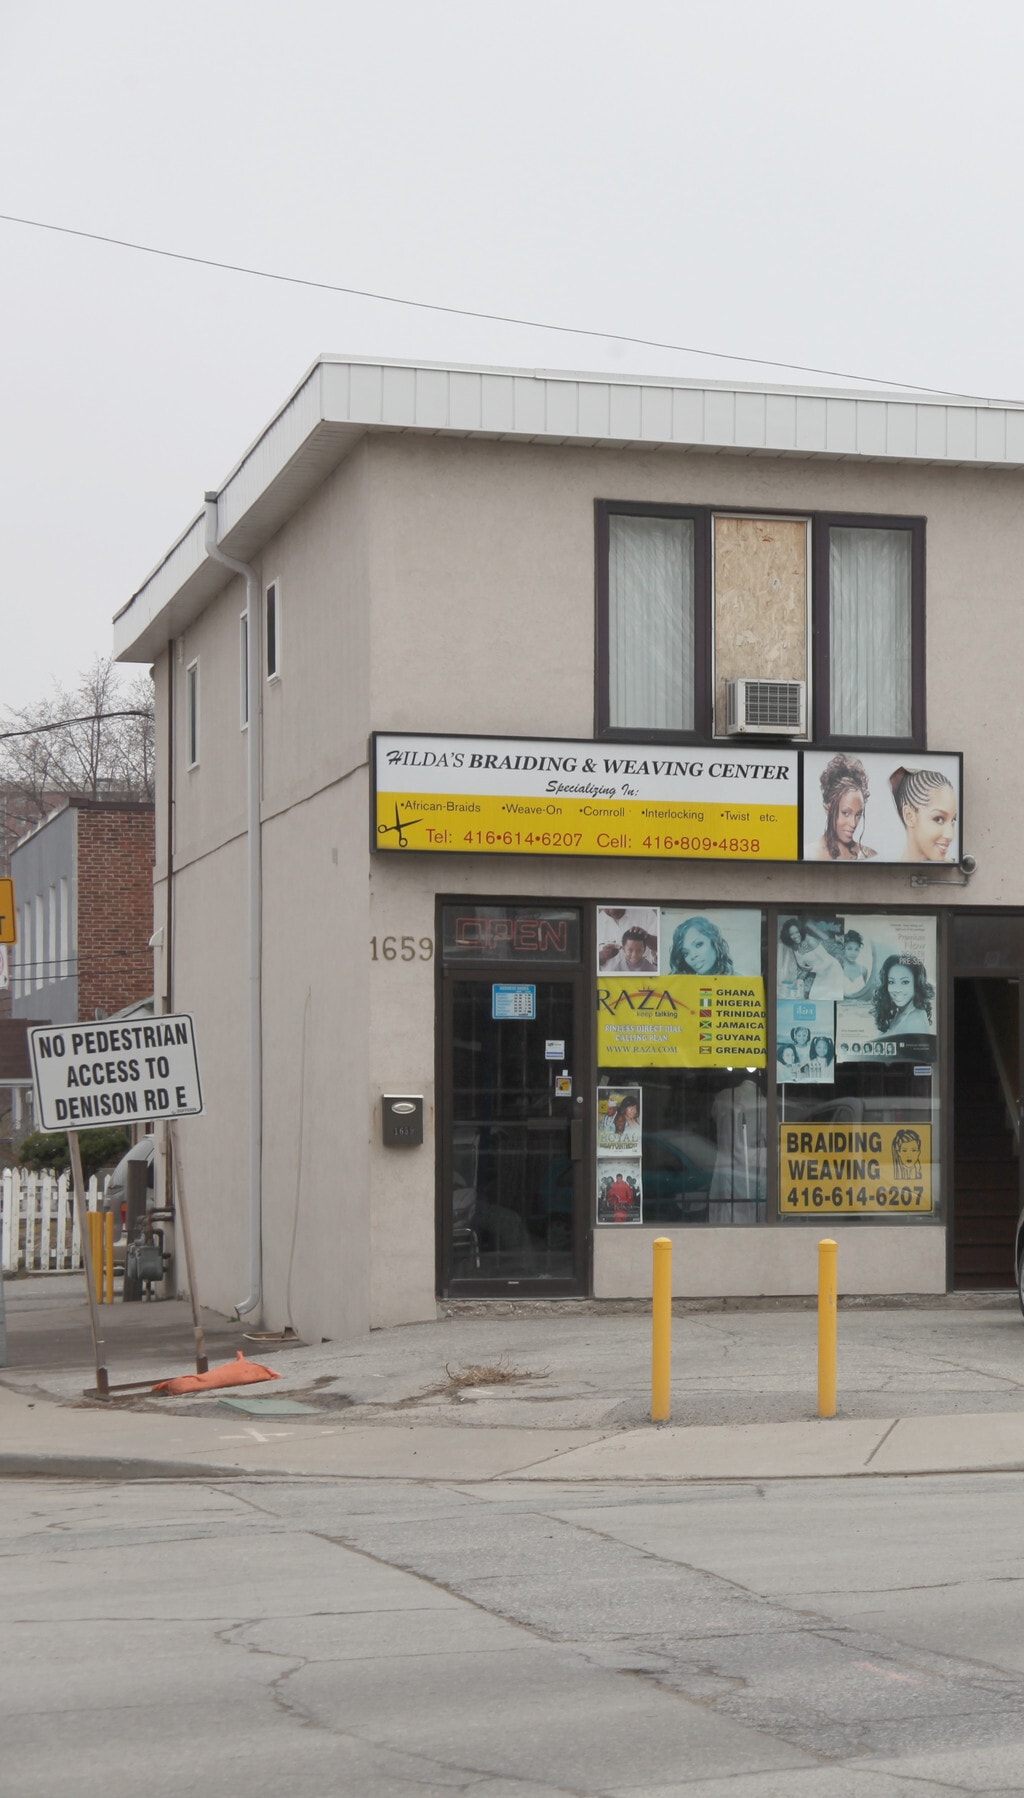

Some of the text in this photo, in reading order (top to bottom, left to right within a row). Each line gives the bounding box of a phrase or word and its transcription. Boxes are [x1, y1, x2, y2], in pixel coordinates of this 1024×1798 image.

[386, 750, 790, 780] HILDA'S BRAIDING & WEAVING CENTER
[545, 780, 640, 798] Specializing In:
[759, 812, 778, 822] etc.
[426, 828, 452, 844] Tel:
[597, 833, 632, 849] Cell:
[456, 918, 568, 951] OPEN
[369, 936, 433, 961] 1659
[597, 988, 678, 1016] RAZA
[716, 989, 755, 997] GHANA
[716, 999, 761, 1007] NIGERIA
[655, 1010, 678, 1019] talking
[716, 1010, 766, 1018] TRINIDAD
[716, 1021, 764, 1029] JAMAICA
[39, 1022, 188, 1059] NO PEDESTRIAN
[716, 1033, 761, 1042] GUYANA
[716, 1046, 766, 1055] GRENADA
[67, 1056, 170, 1088] ACCESS TO
[55, 1086, 188, 1121] DENISON RD E
[786, 1131, 882, 1153] BRAIDING
[787, 1159, 881, 1181] WEAVING
[787, 1186, 924, 1207] 416-614-6207
